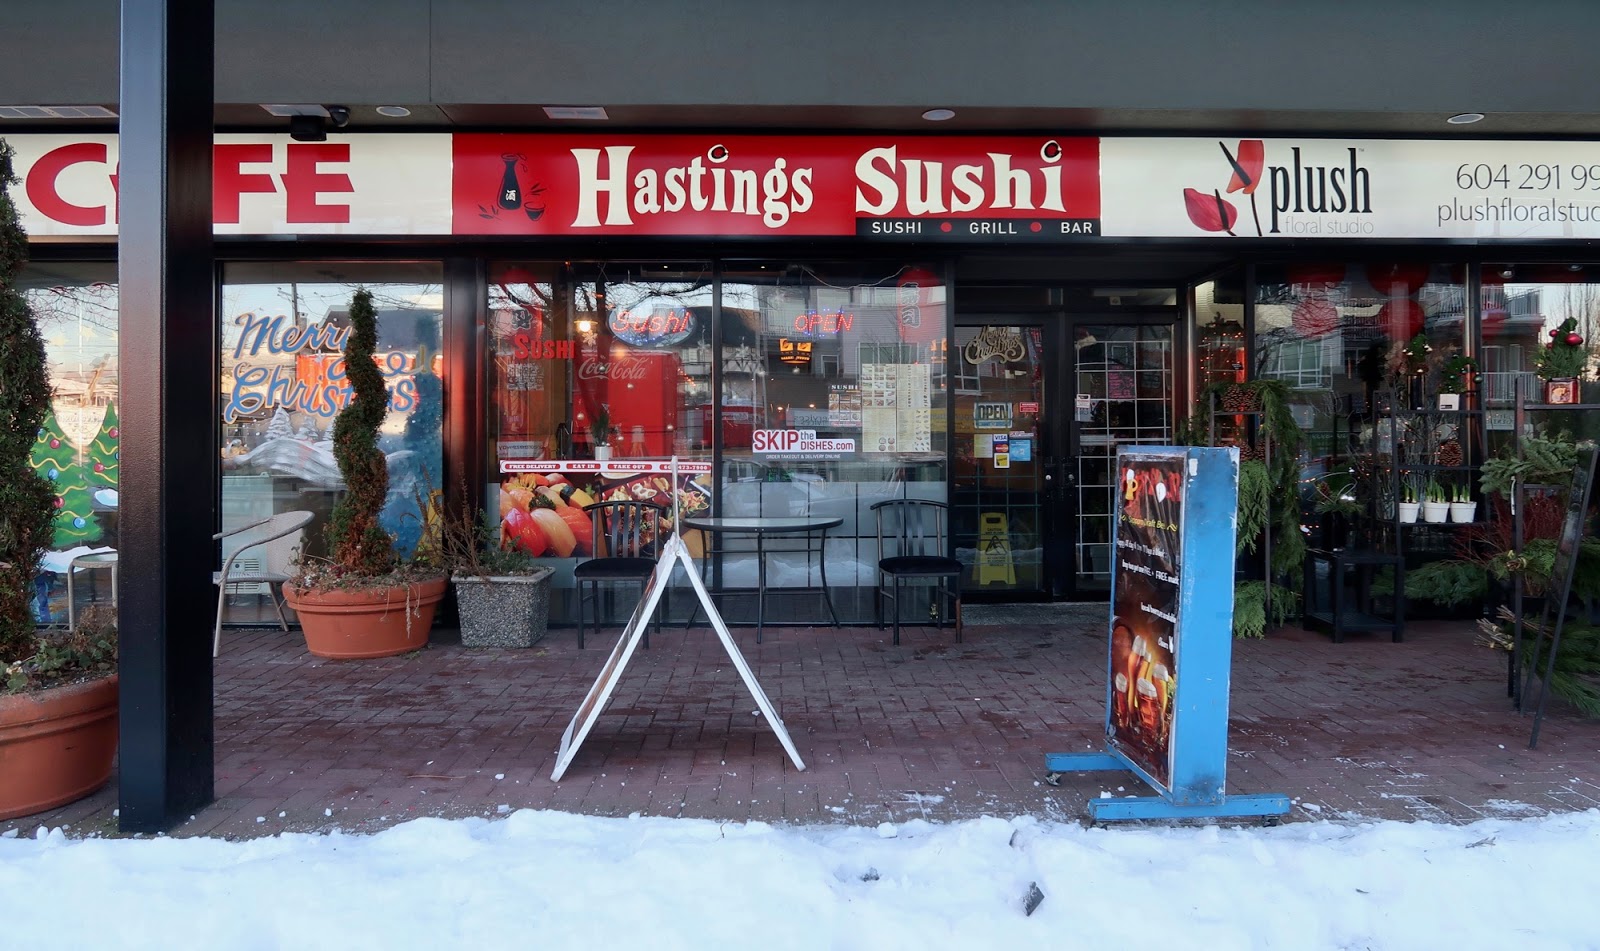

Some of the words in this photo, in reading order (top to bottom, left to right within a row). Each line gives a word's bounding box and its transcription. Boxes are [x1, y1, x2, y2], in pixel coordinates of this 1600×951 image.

[26, 142, 355, 226] CFE
[570, 144, 813, 228] Hastings
[855, 140, 1067, 216] Sushi
[1456, 163, 1510, 190] 604
[1518, 164, 1560, 190] 291
[1268, 147, 1373, 233] plush
[872, 221, 923, 234] SUSHI
[969, 222, 1017, 234] GRILL
[1060, 222, 1093, 234] BAR
[1285, 215, 1322, 233] floral
[1327, 215, 1374, 234] studio
[612, 310, 692, 334] Sushi
[794, 313, 854, 332] OPEN
[514, 333, 576, 359] SUSHI
[978, 404, 1009, 420] OPEN
[754, 431, 799, 451] SKIP
[800, 431, 814, 440] the
[800, 441, 853, 451] DISHES.com
